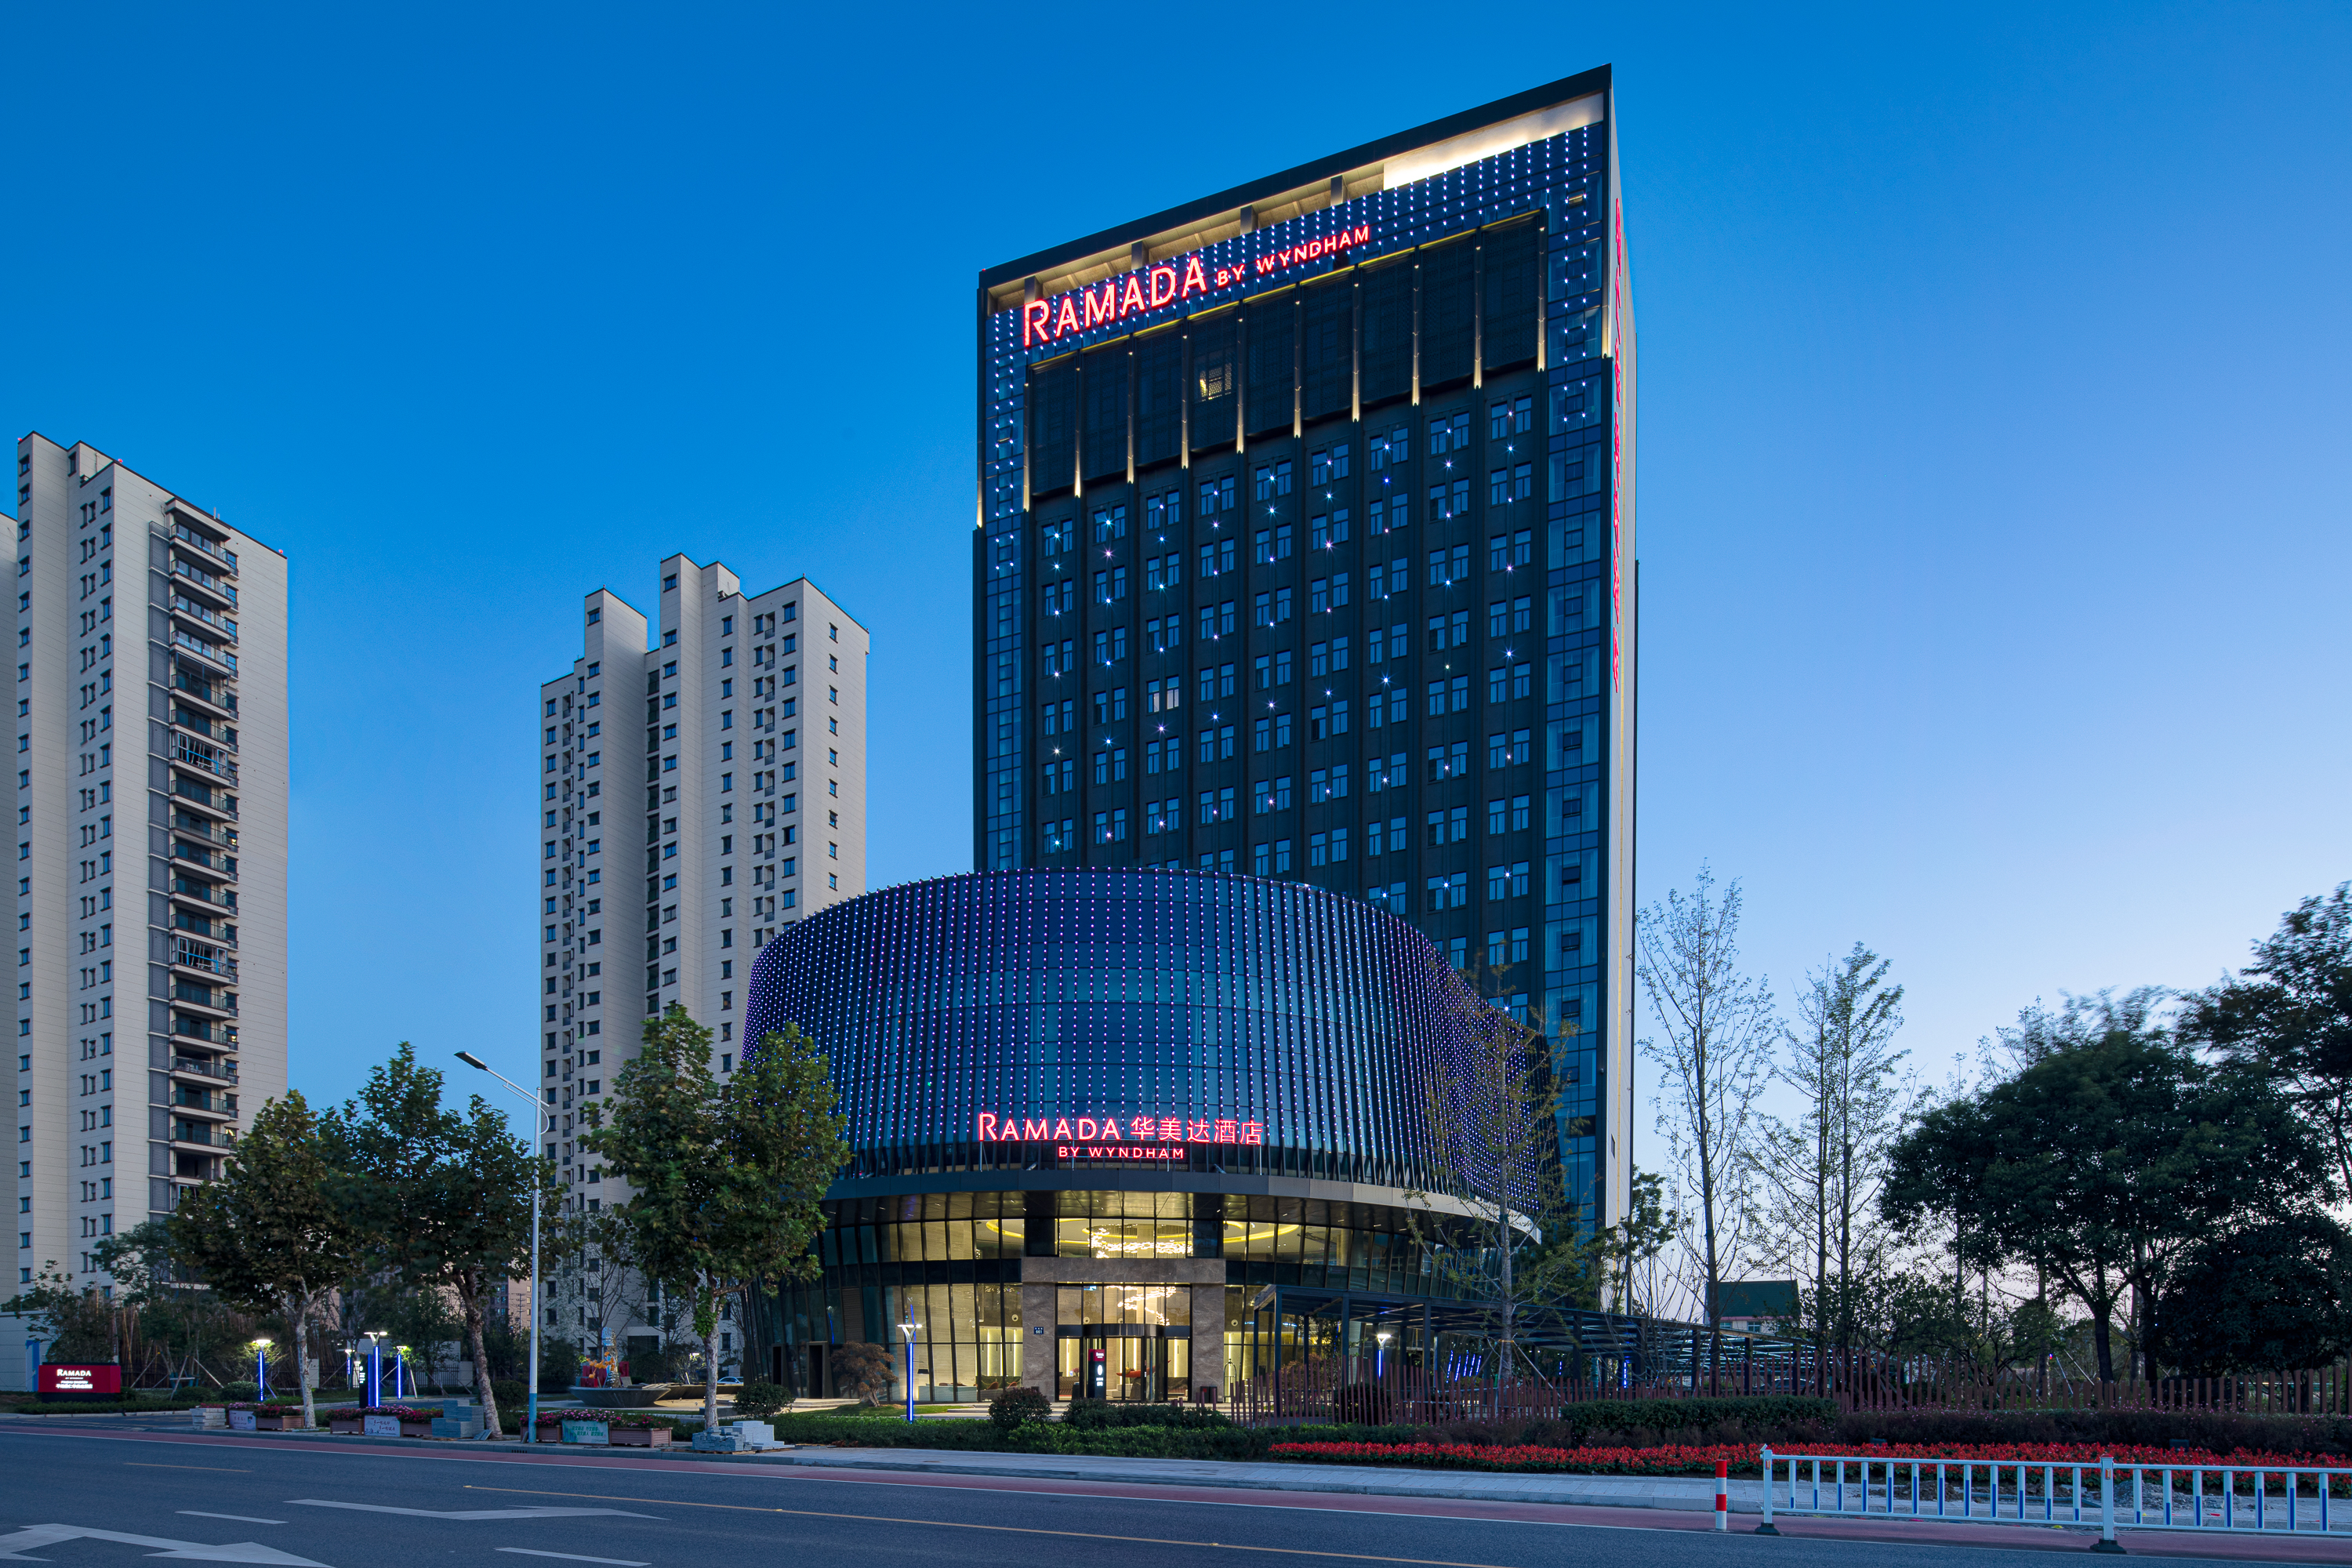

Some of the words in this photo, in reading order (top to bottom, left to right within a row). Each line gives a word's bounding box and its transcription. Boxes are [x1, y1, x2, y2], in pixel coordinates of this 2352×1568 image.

[1024, 257, 1207, 347] RAMADA
[1217, 265, 1245, 287] BY
[1257, 226, 1370, 274] WYNDHAM
[978, 1113, 1121, 1141] RAMADA
[1130, 1116, 1264, 1145] 华美达酒店
[1058, 1146, 1080, 1158] BY
[1089, 1147, 1184, 1160] WYNDHAM
